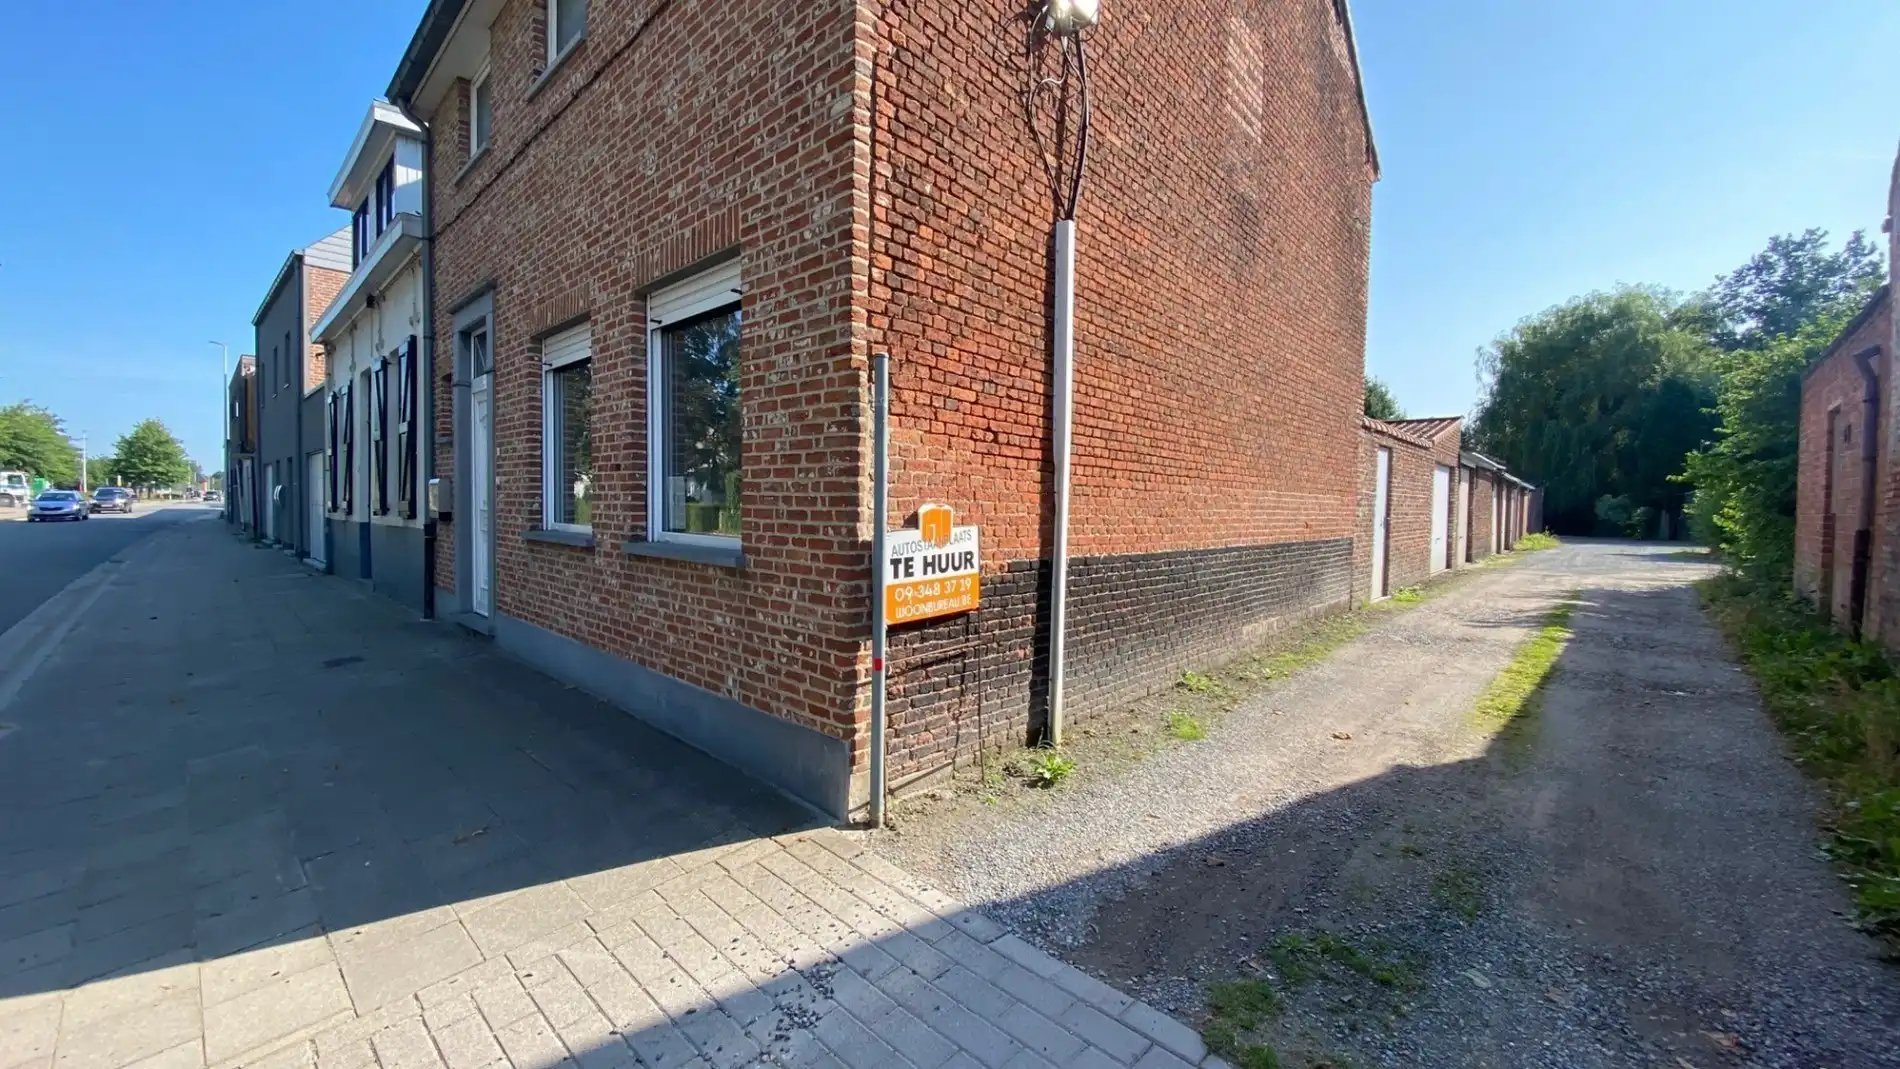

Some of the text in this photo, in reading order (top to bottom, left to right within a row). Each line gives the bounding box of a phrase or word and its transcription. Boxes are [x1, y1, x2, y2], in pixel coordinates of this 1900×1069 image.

[890, 550, 975, 579] TE HUUR
[944, 579, 957, 594] 37
[960, 577, 972, 592] 19
